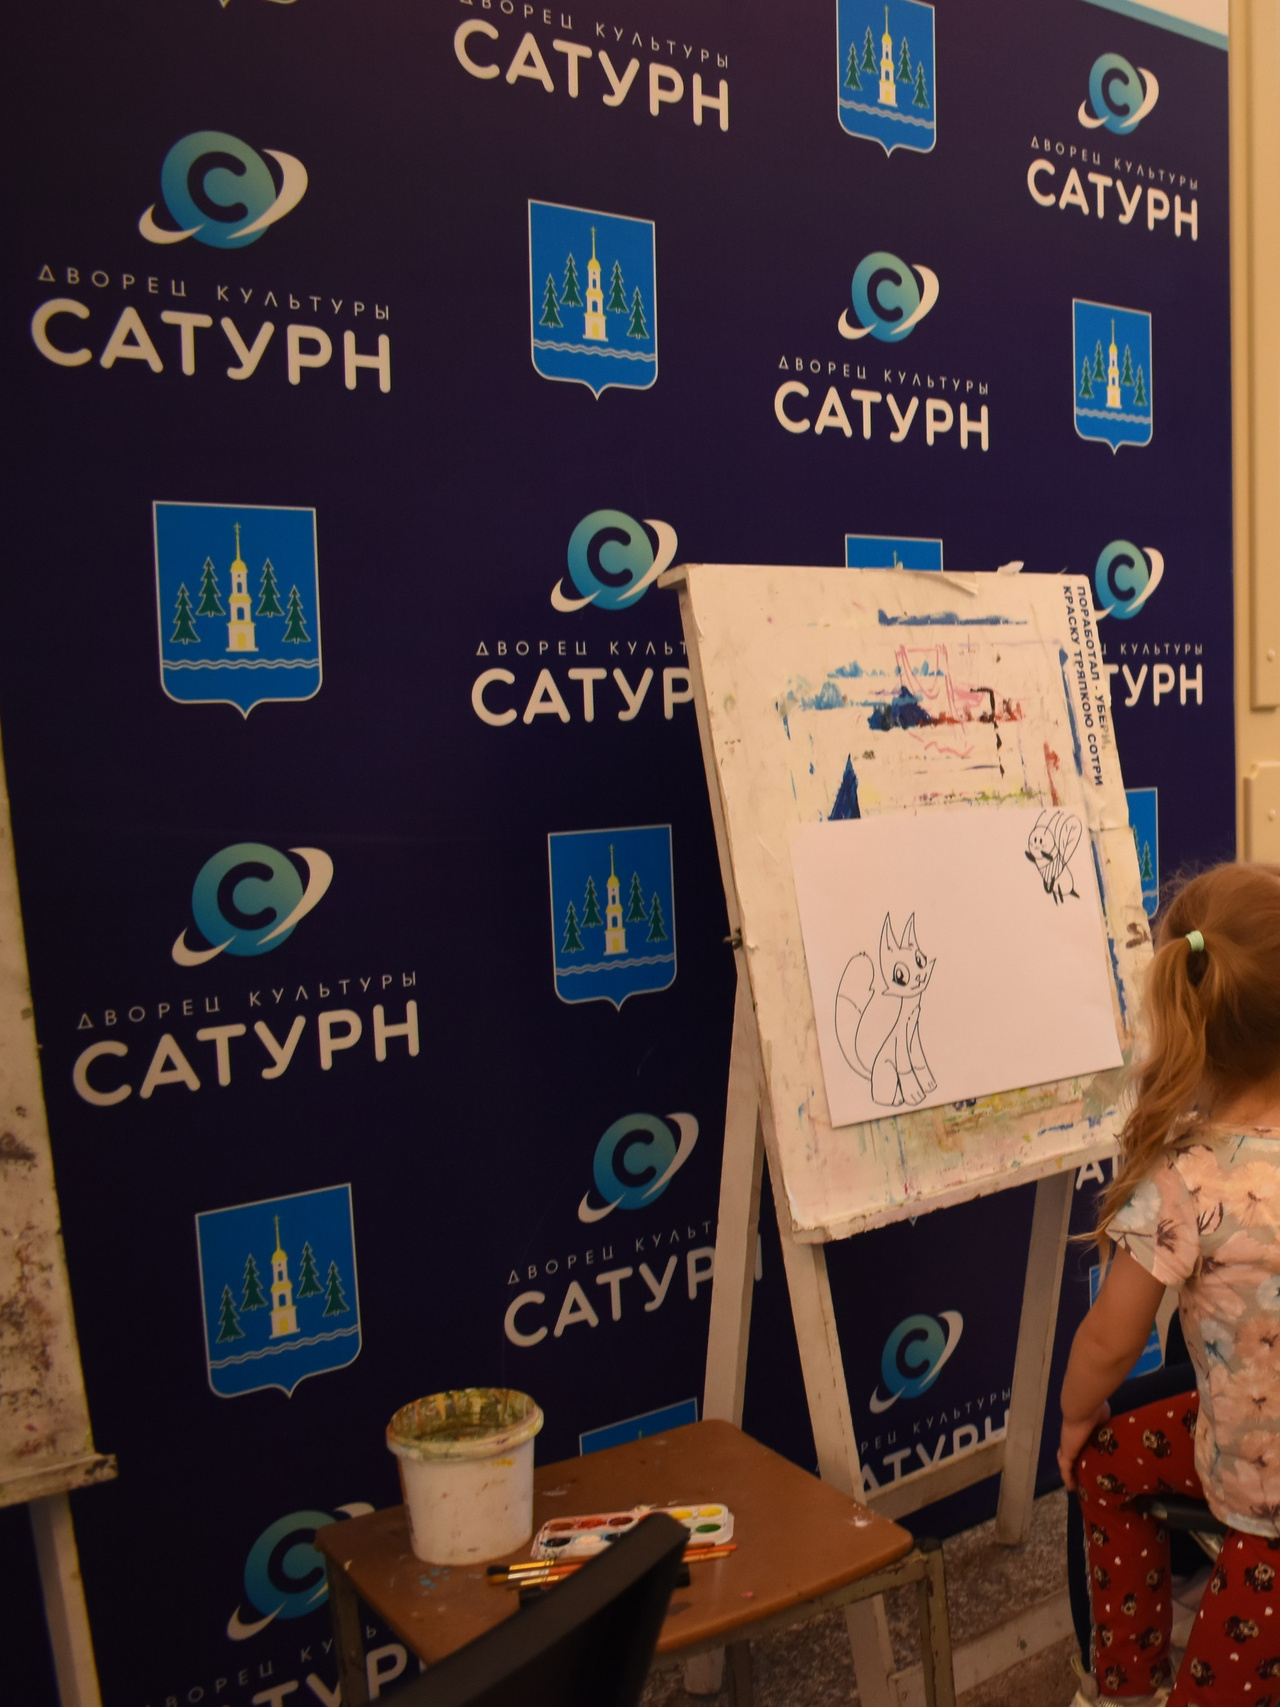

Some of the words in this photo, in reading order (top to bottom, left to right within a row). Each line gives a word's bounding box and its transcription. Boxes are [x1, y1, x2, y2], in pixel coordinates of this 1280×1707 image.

[596, 22, 728, 68] КУЛЬТУРЫ
[454, 19, 729, 132] САТУРН
[1031, 136, 1101, 165] ДВОРЕЦ
[1114, 157, 1198, 191] КУЛЬТУРЫ
[1027, 158, 1198, 241] САТУРН
[38, 264, 186, 297] ДВОРЕЦ
[217, 285, 389, 320] КУЛЬТУРЫ
[31, 298, 391, 393] САТУРН
[778, 355, 867, 379] ДВОРЕЦ
[884, 369, 988, 395] КУЛЬТУРЫ
[774, 380, 989, 452] САТУРН
[476, 641, 587, 656] ДВОРЕЦ
[610, 641, 688, 656] КУЛЬТ
[1077, 586, 1100, 681] ПОРАБОТАЛ
[1120, 643, 1203, 656] КУЛЬТУРЫ
[471, 668, 694, 727] САТУР
[1063, 586, 1080, 646] КРАСКУ
[1074, 650, 1094, 728] ТРЯПКОЮ
[1087, 733, 1103, 786] СОТРИ
[1103, 664, 1203, 707] ТУРН
[77, 997, 220, 1030] ДВОРЕЦ
[250, 971, 416, 1007] КУЛЬТУРЫ
[73, 1000, 419, 1106] САТУРН
[507, 1246, 614, 1285] ДВОРЕЦ
[636, 1220, 712, 1252] КУЛЬТ
[504, 1233, 763, 1347] САТУР
[913, 1388, 1011, 1433] КУЛЬТУРЫ
[146, 1660, 273, 1707] ВОРЕЦ
